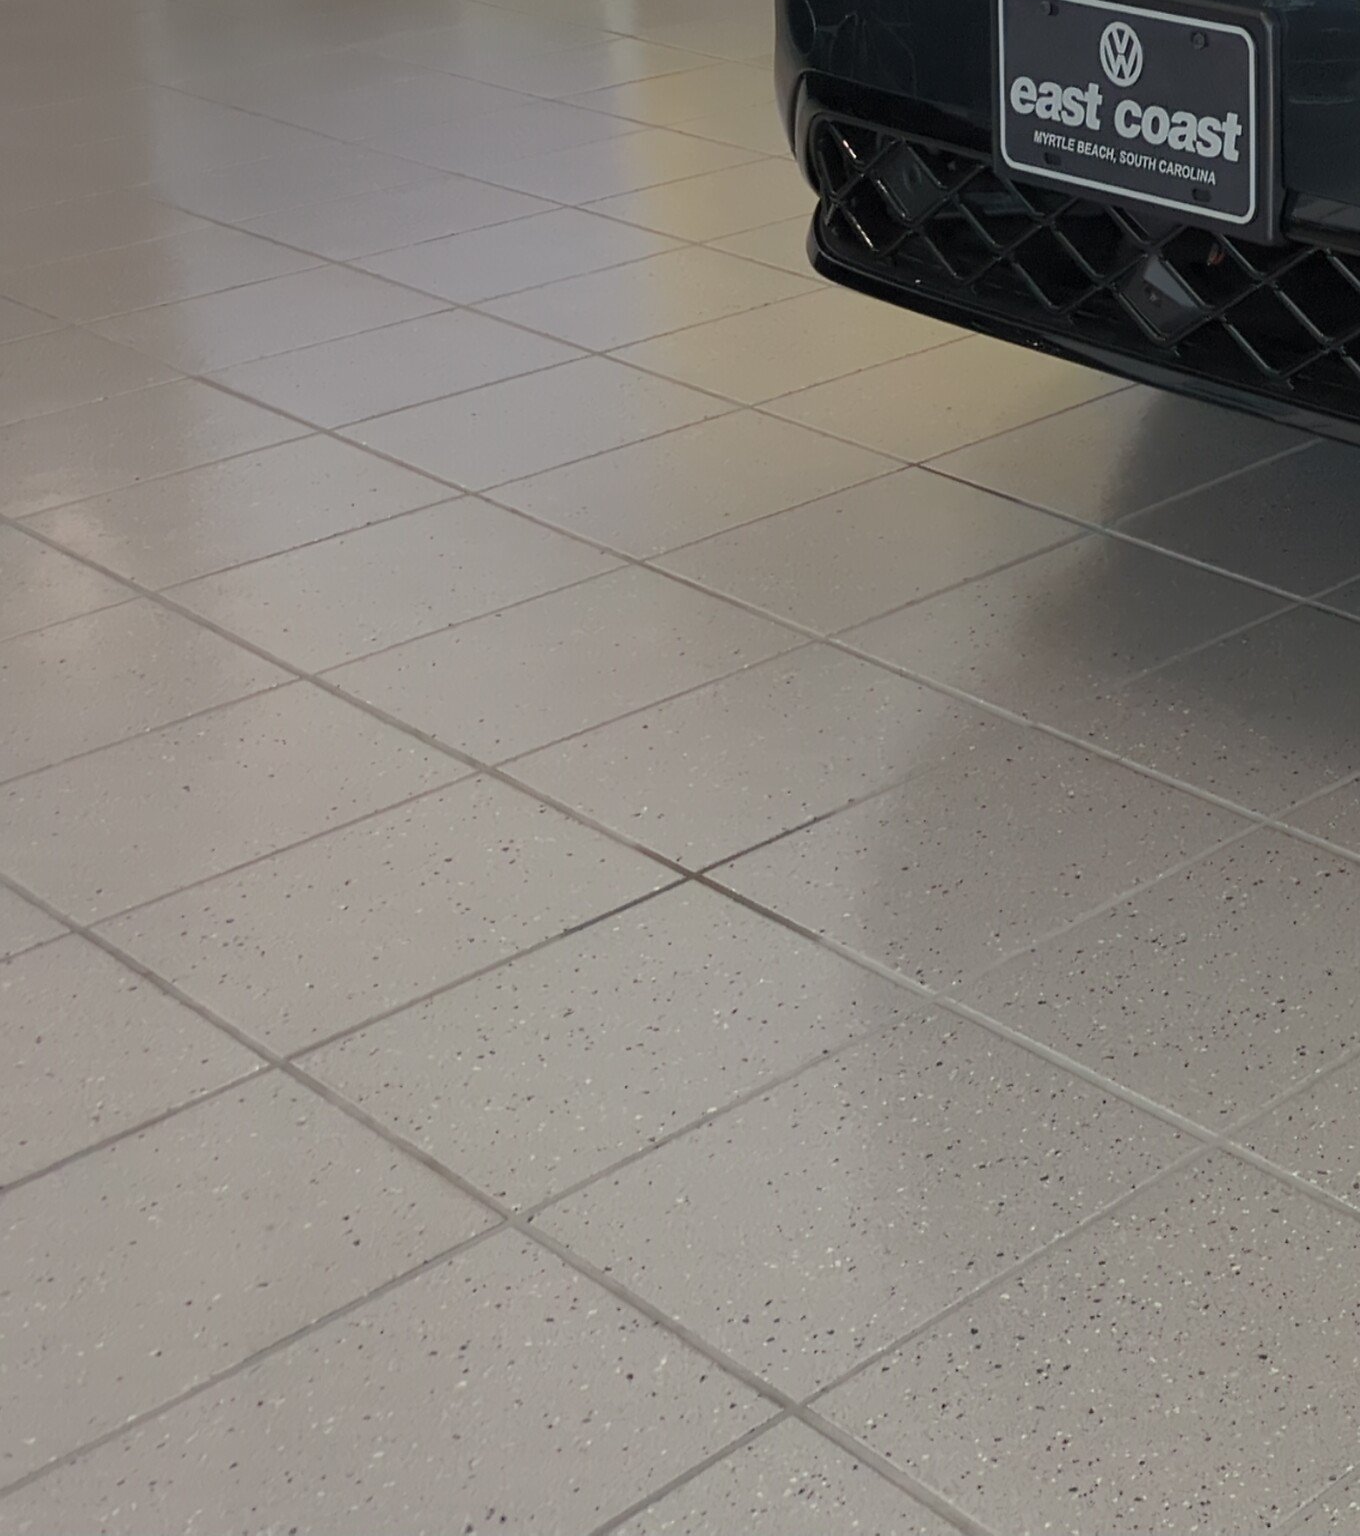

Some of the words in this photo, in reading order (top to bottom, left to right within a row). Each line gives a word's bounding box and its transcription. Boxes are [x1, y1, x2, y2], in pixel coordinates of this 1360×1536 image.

[1100, 21, 1143, 88] VW
[1010, 76, 1103, 131] east
[1114, 99, 1243, 162] coast
[1033, 130, 1075, 152] MYRTLE
[1077, 140, 1117, 164] BEACH,
[1119, 150, 1157, 171] SOUTH
[1158, 159, 1216, 186] CAROLINA
